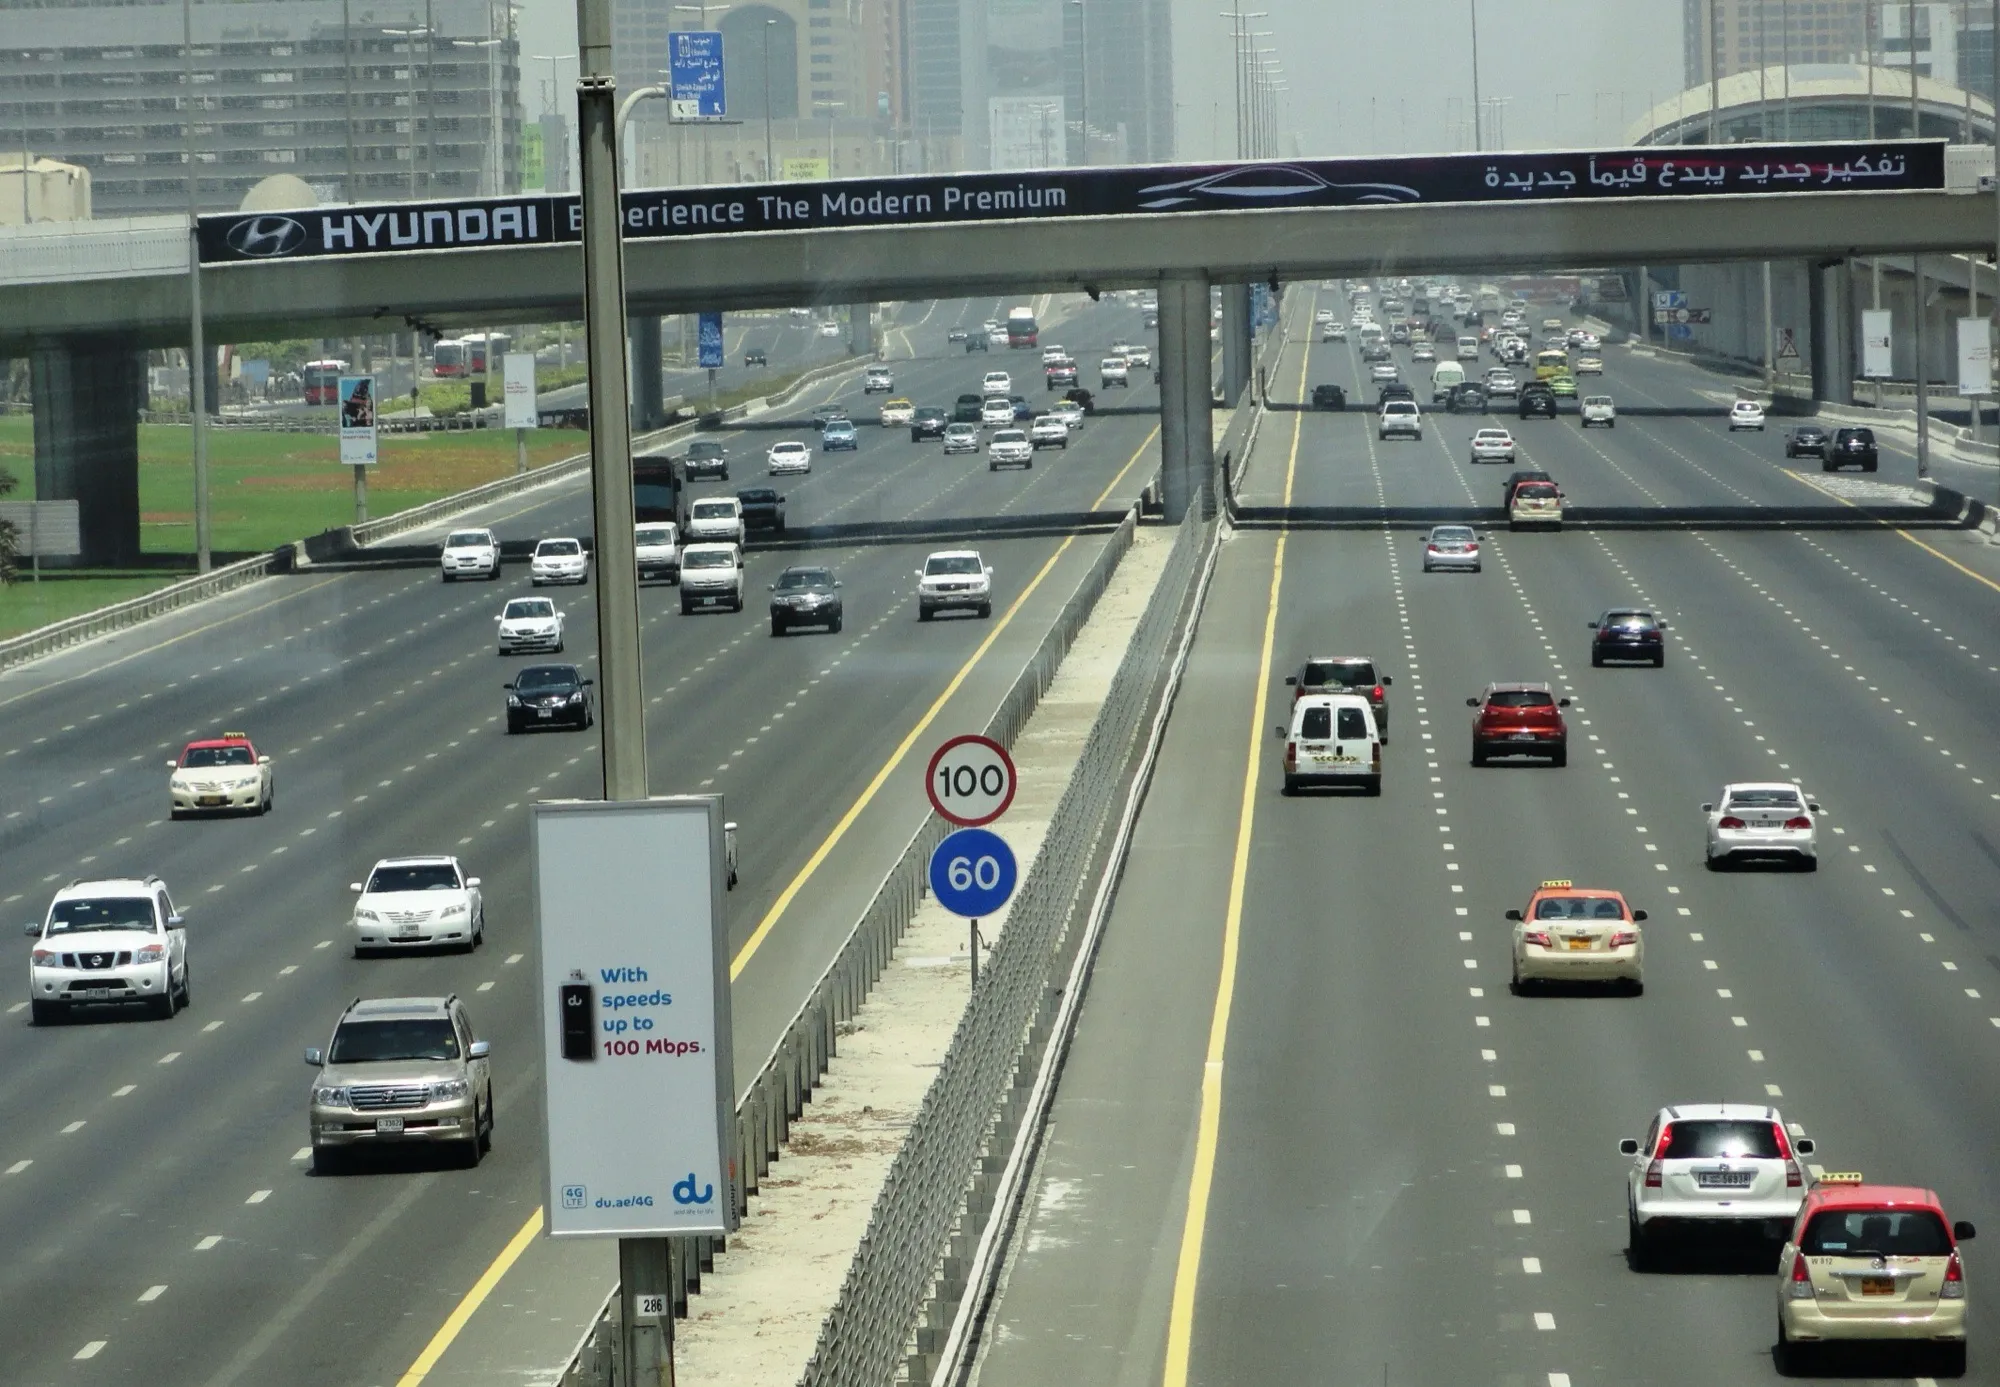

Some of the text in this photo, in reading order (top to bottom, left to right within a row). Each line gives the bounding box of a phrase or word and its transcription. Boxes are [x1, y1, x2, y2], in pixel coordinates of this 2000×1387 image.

[1485, 153, 1905, 191] تفكير جديد يبدع قيماً جديدة
[568, 184, 1066, 231] Eerience The Modern Premium
[322, 205, 538, 249] HYUNDAI
[939, 764, 1003, 797] 100
[948, 855, 1000, 891] 60
[601, 967, 648, 983] With
[568, 995, 582, 1006] du
[602, 990, 672, 1011] speeds
[603, 1016, 654, 1035] up to
[604, 1038, 706, 1057] 100 Mbps.
[566, 1188, 583, 1198] 4G
[673, 1172, 713, 1204] du
[566, 1198, 583, 1206] LTE
[595, 1195, 654, 1208] du.ae/4G
[644, 1299, 662, 1312] 286
